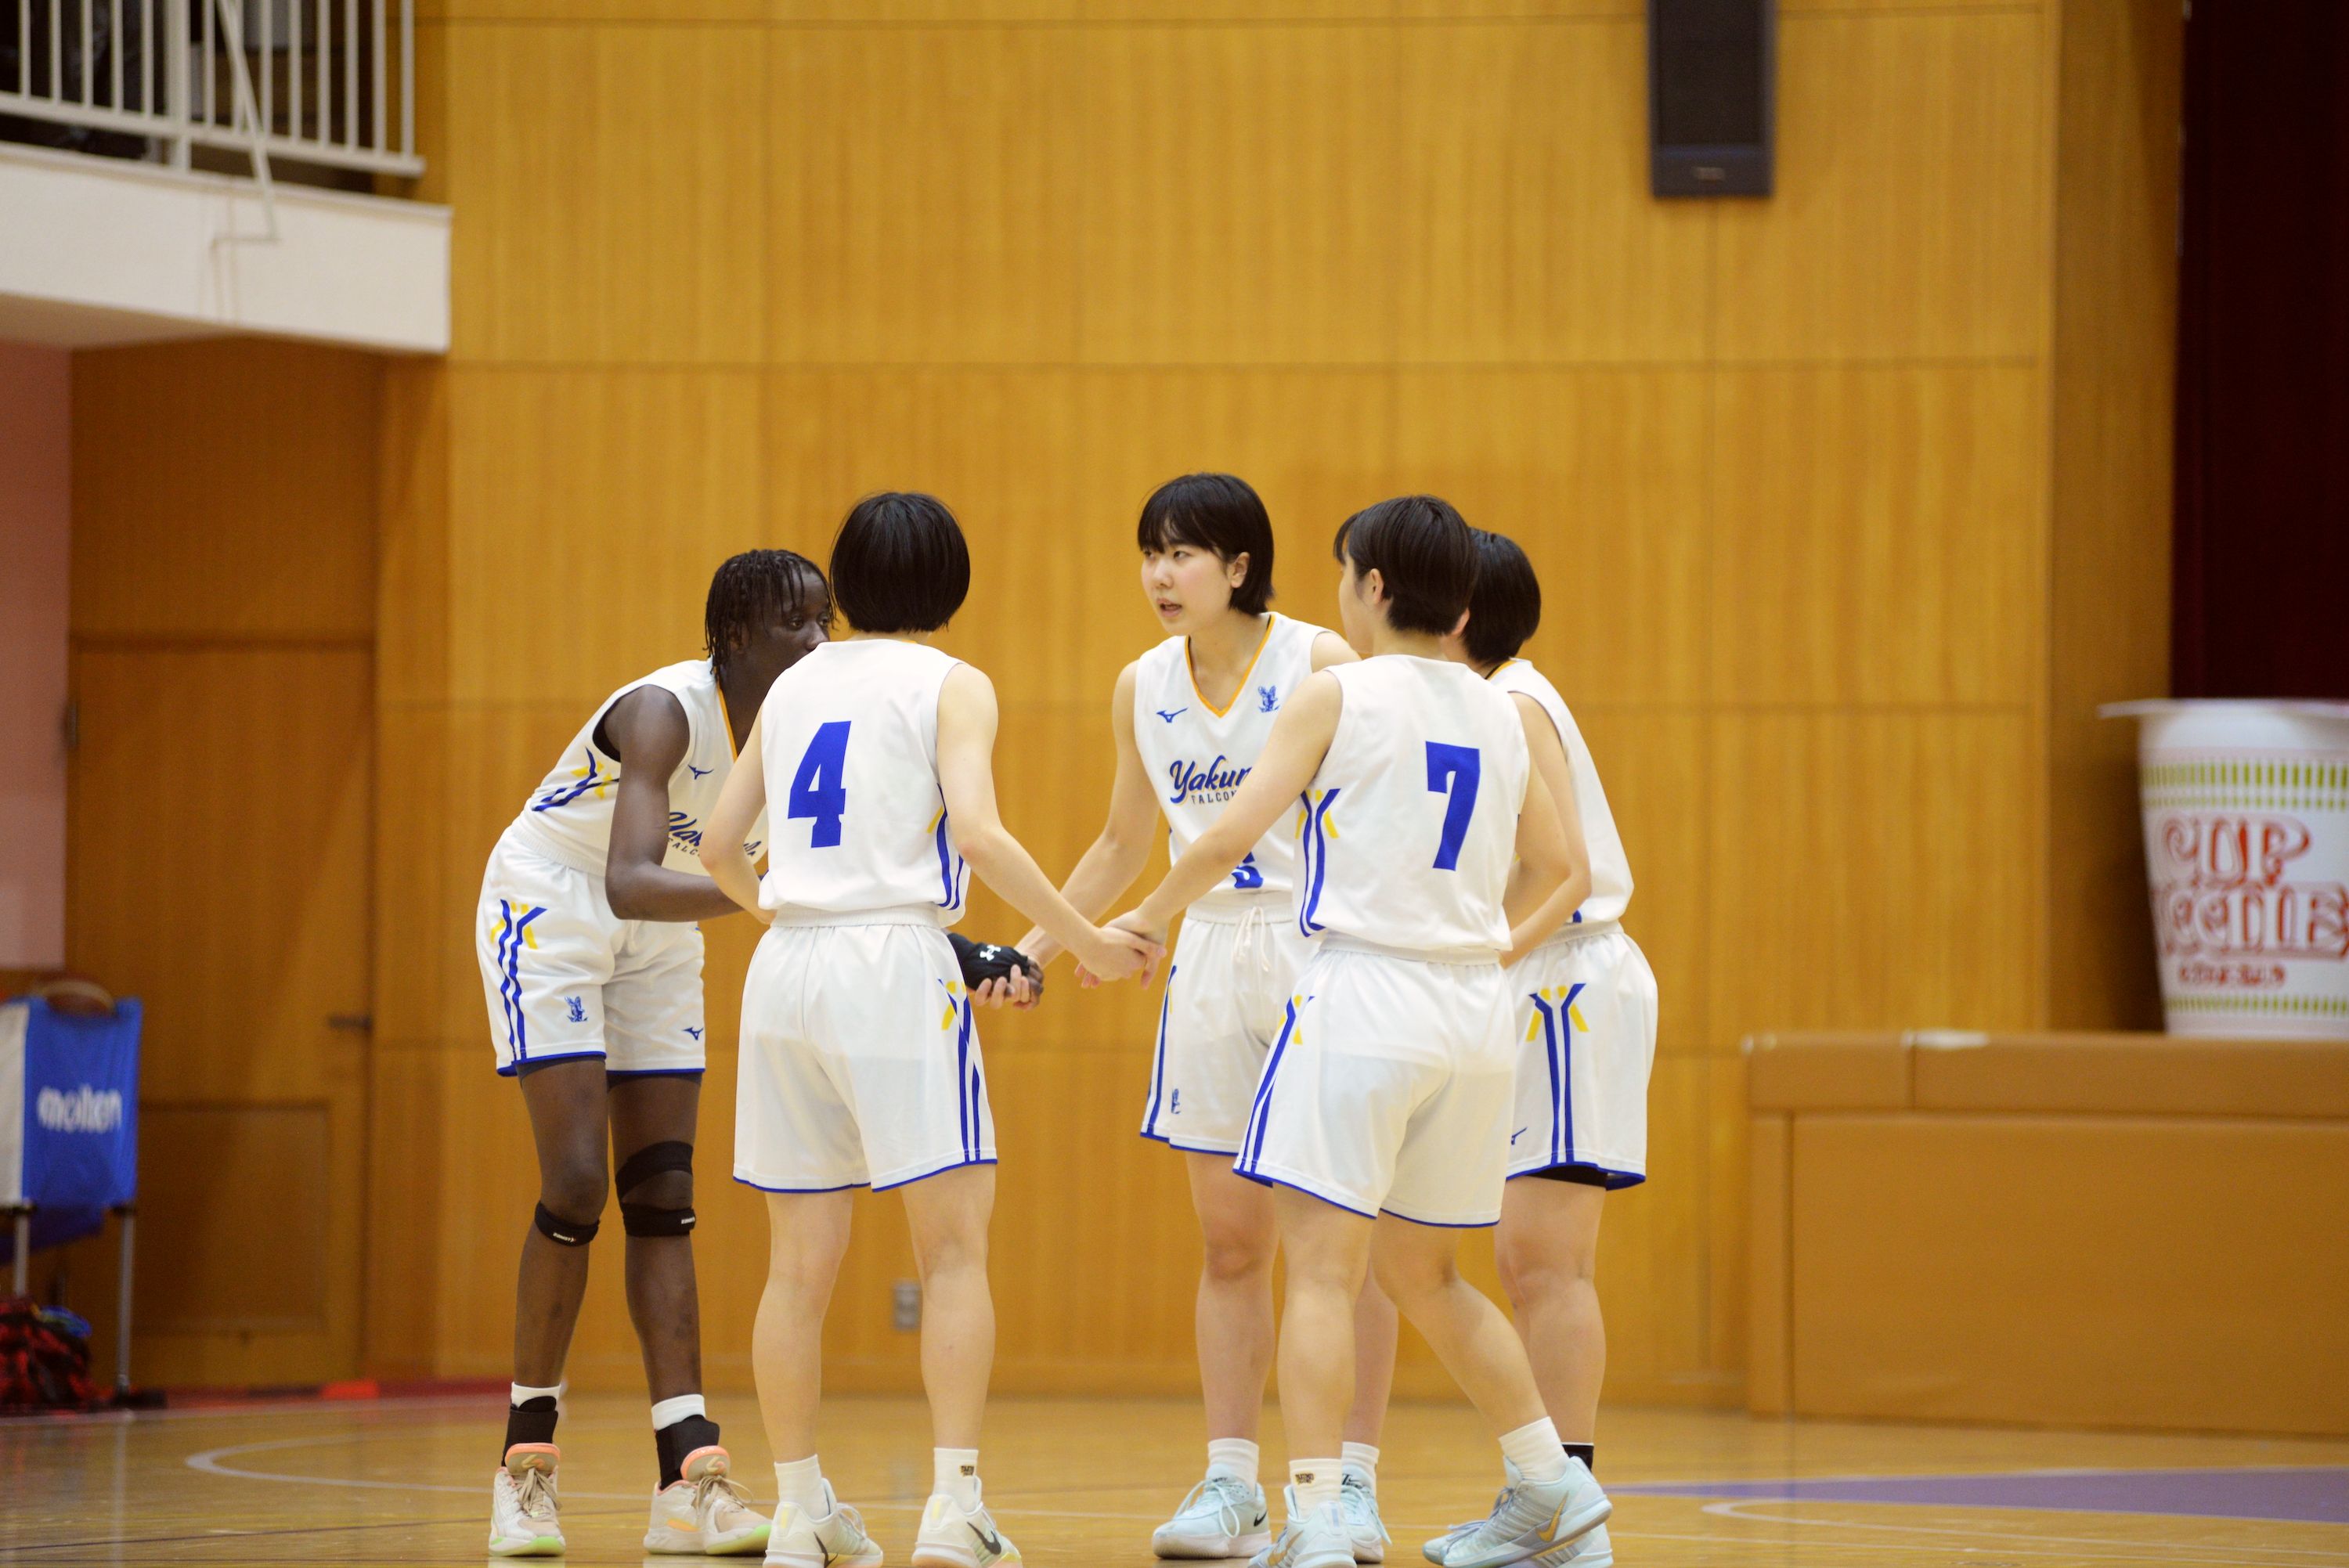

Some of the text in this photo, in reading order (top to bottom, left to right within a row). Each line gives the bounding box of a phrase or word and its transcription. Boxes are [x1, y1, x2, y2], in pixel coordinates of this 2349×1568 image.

[788, 720, 851, 848] 4
[1425, 741, 1481, 871] 7
[2158, 816, 2312, 889] CUP
[37, 1085, 122, 1134] molten
